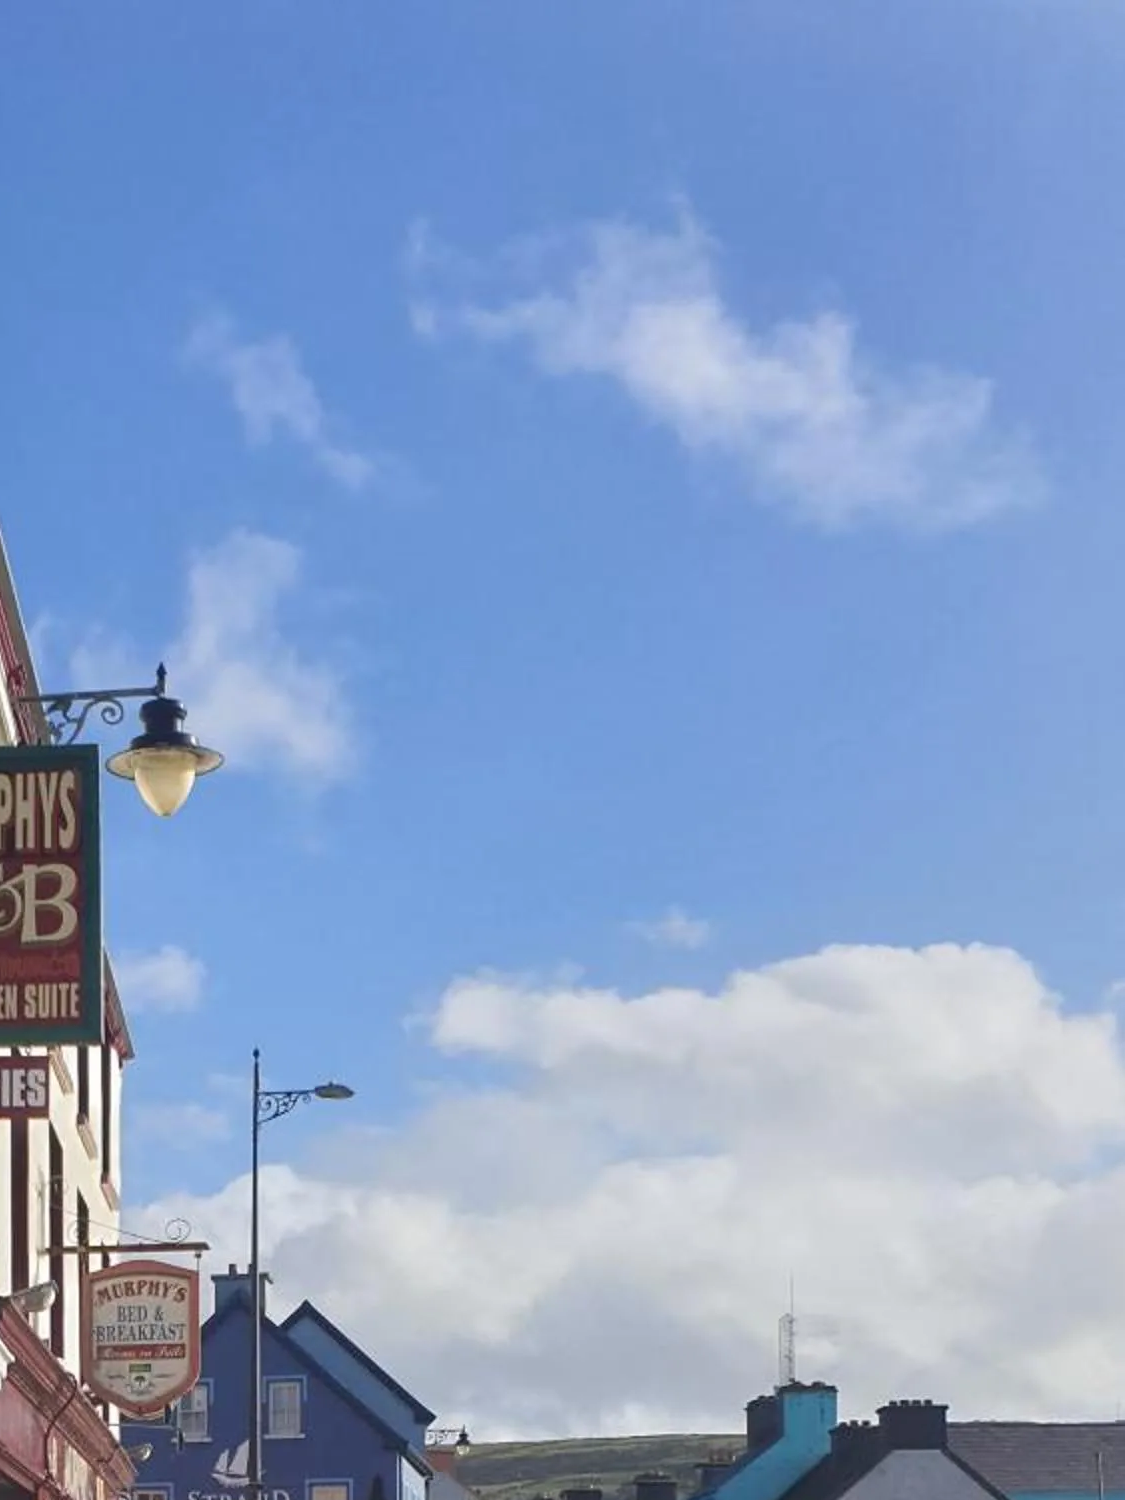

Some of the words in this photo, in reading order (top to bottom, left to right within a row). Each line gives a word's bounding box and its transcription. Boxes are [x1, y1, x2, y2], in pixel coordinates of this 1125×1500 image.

[24, 983, 80, 1019] SUITE
[94, 1280, 187, 1305] MURPHY'S
[117, 1305, 147, 1323] BED
[155, 1305, 164, 1322] &
[95, 1324, 186, 1342] BREAKFAST
